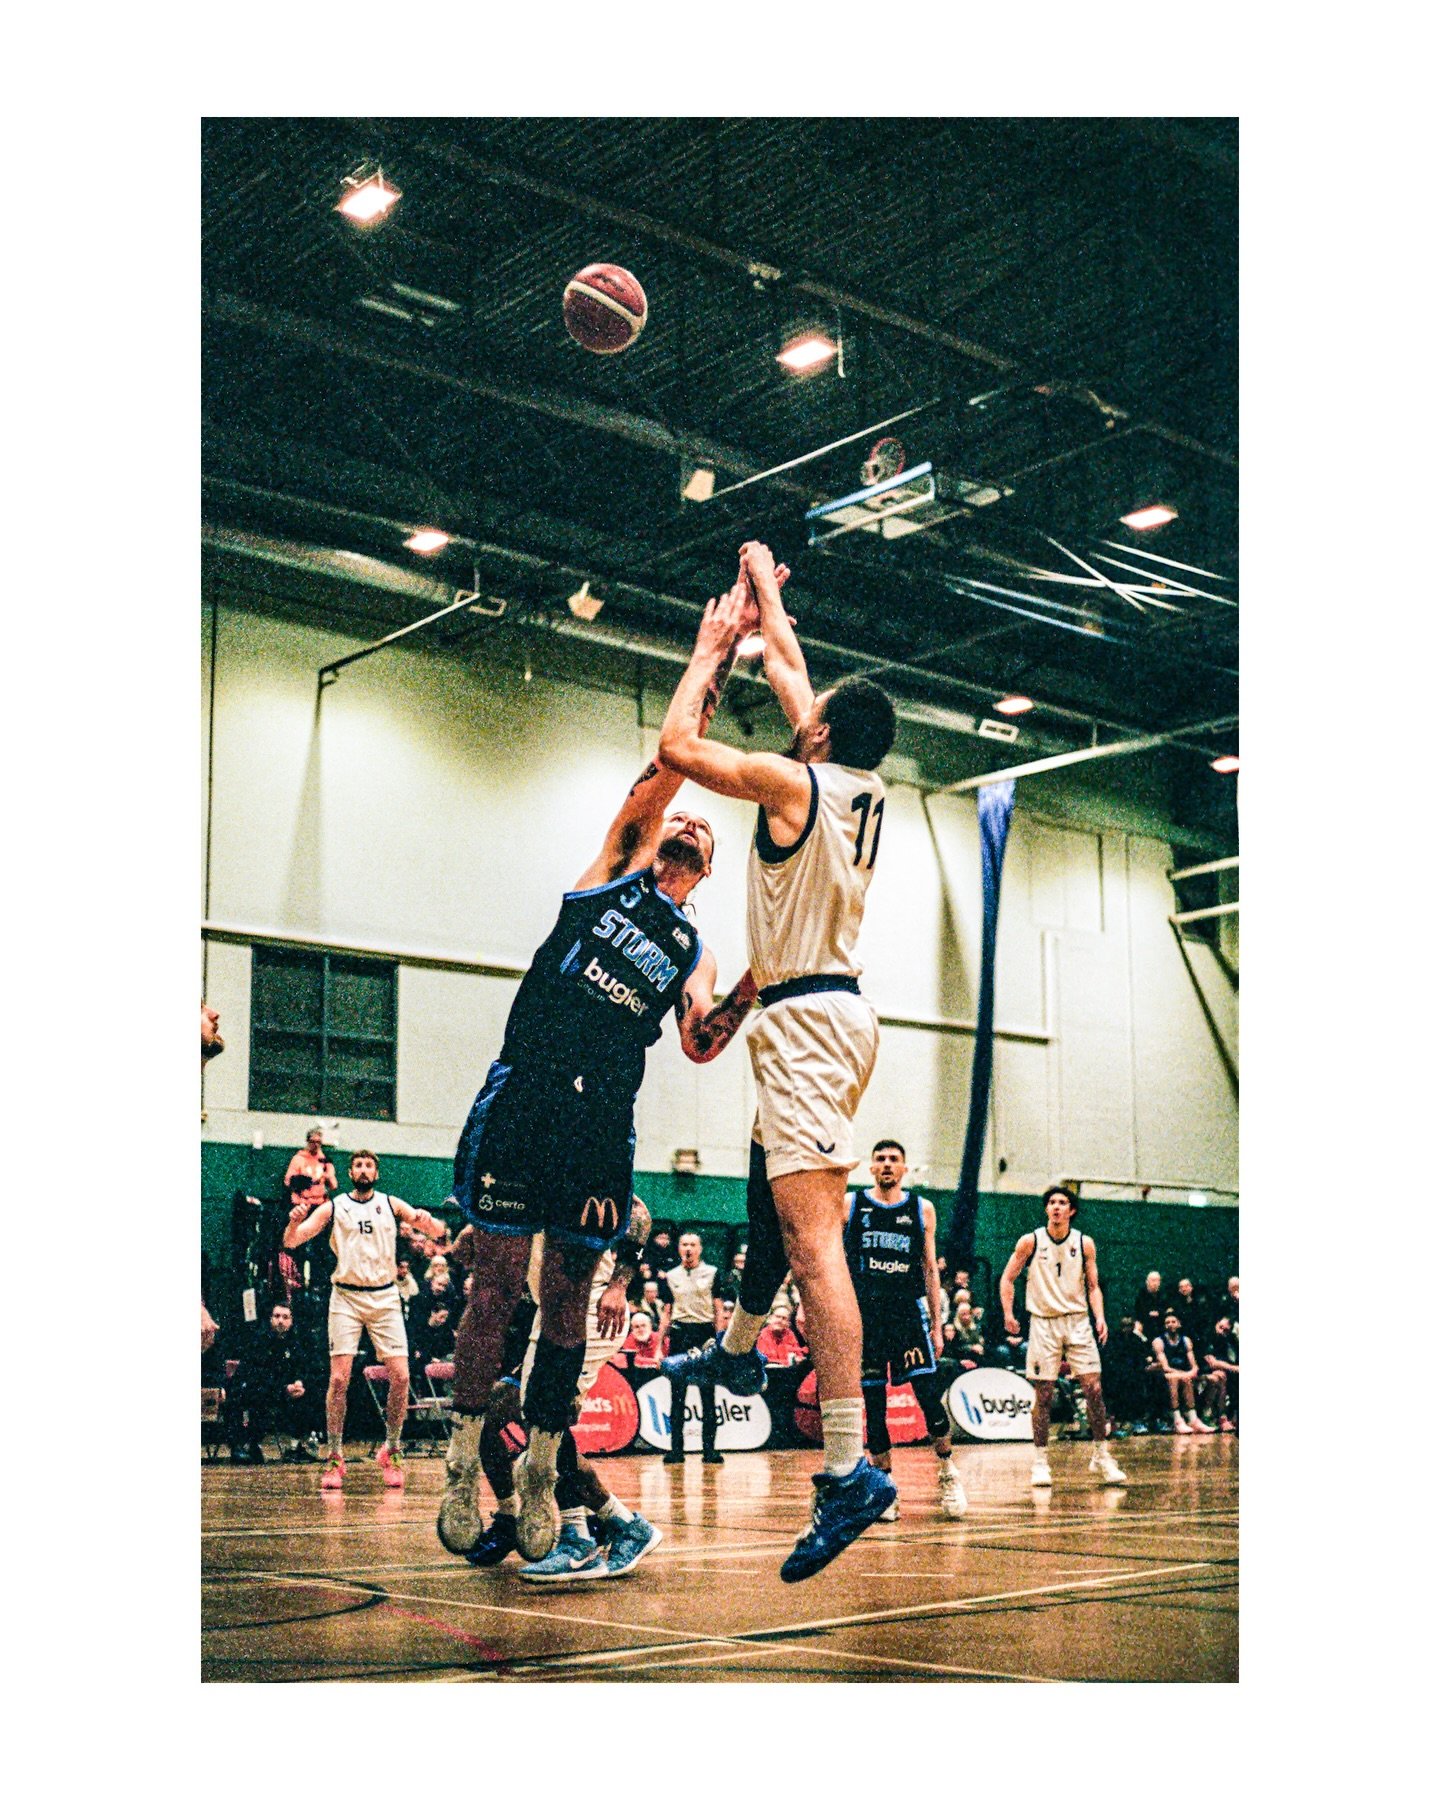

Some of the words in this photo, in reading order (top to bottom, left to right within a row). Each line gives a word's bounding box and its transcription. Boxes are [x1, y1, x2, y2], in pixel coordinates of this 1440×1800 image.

[851, 792, 885, 869] 11
[619, 885, 643, 909] 3
[592, 909, 679, 993] STORM
[583, 957, 649, 1016] bugler
[357, 1220, 374, 1235] 15
[861, 1229, 911, 1253] STORM
[869, 1256, 911, 1274] bugler
[1055, 1261, 1063, 1278] 1
